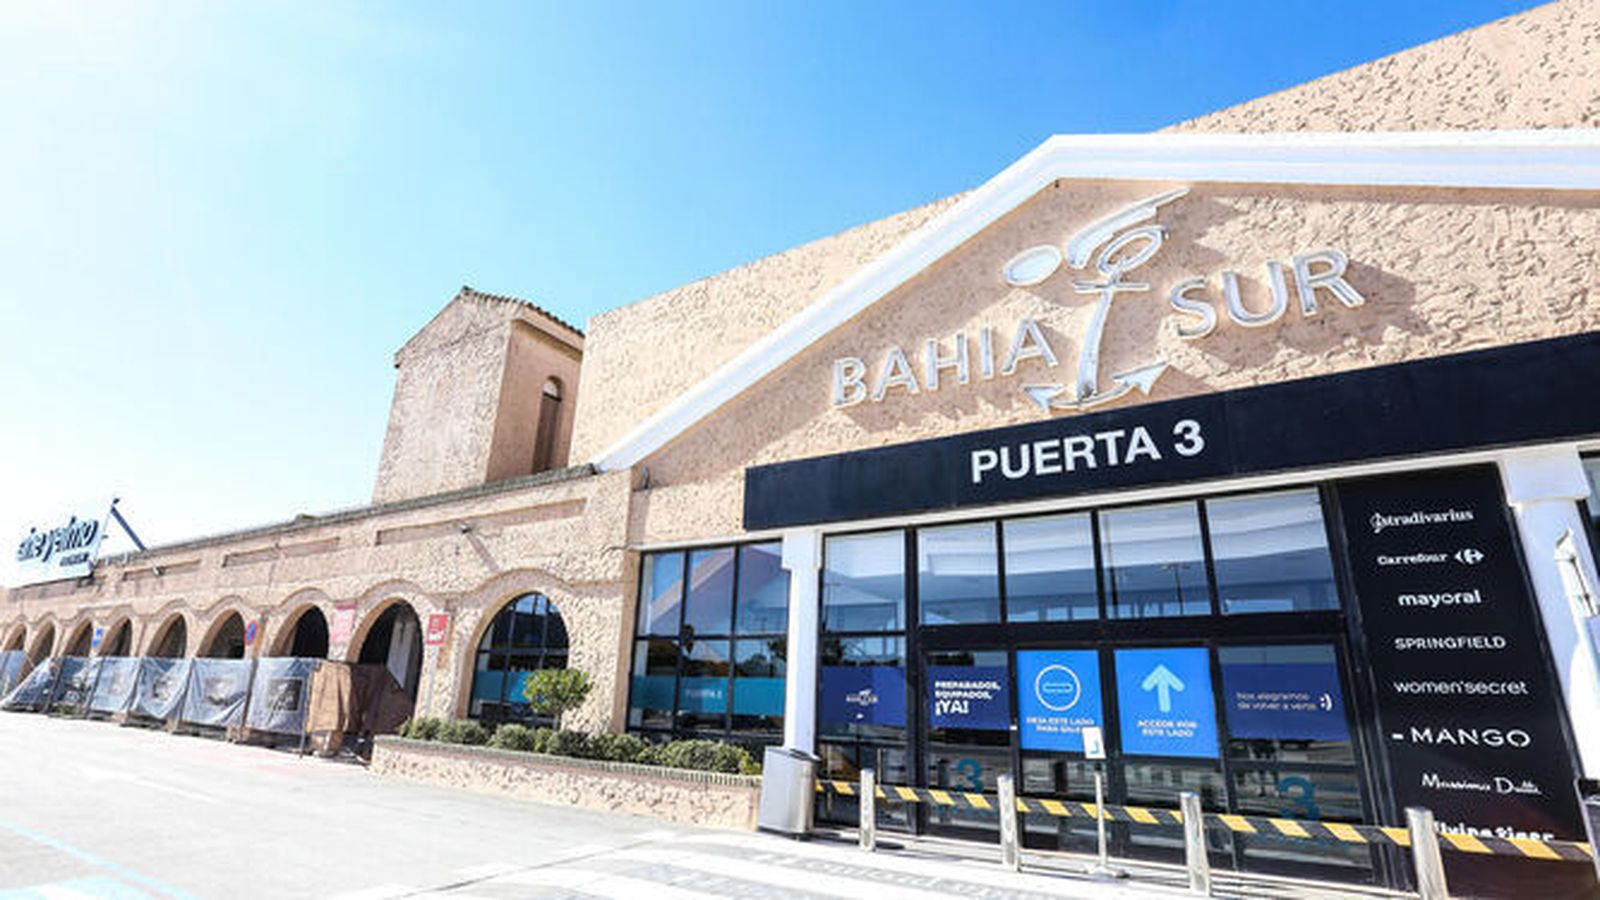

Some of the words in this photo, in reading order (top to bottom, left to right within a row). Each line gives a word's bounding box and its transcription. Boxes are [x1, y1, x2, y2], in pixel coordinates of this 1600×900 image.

[1168, 247, 1365, 340] SUR
[833, 318, 1059, 407] BAHIA
[970, 427, 1162, 484] PUERTA
[1173, 418, 1206, 458] 3
[1376, 552, 1448, 565] Carrefour
[1398, 589, 1482, 608] mayoral
[1394, 635, 1507, 651] SPRINGFIELD
[934, 680, 1001, 691] PREPARADOS,
[1393, 681, 1529, 695] women'secret
[934, 699, 969, 716] ¡YA!
[1070, 717, 1095, 726] LADO
[1167, 729, 1194, 738] LADO
[1410, 727, 1531, 747] MANGO
